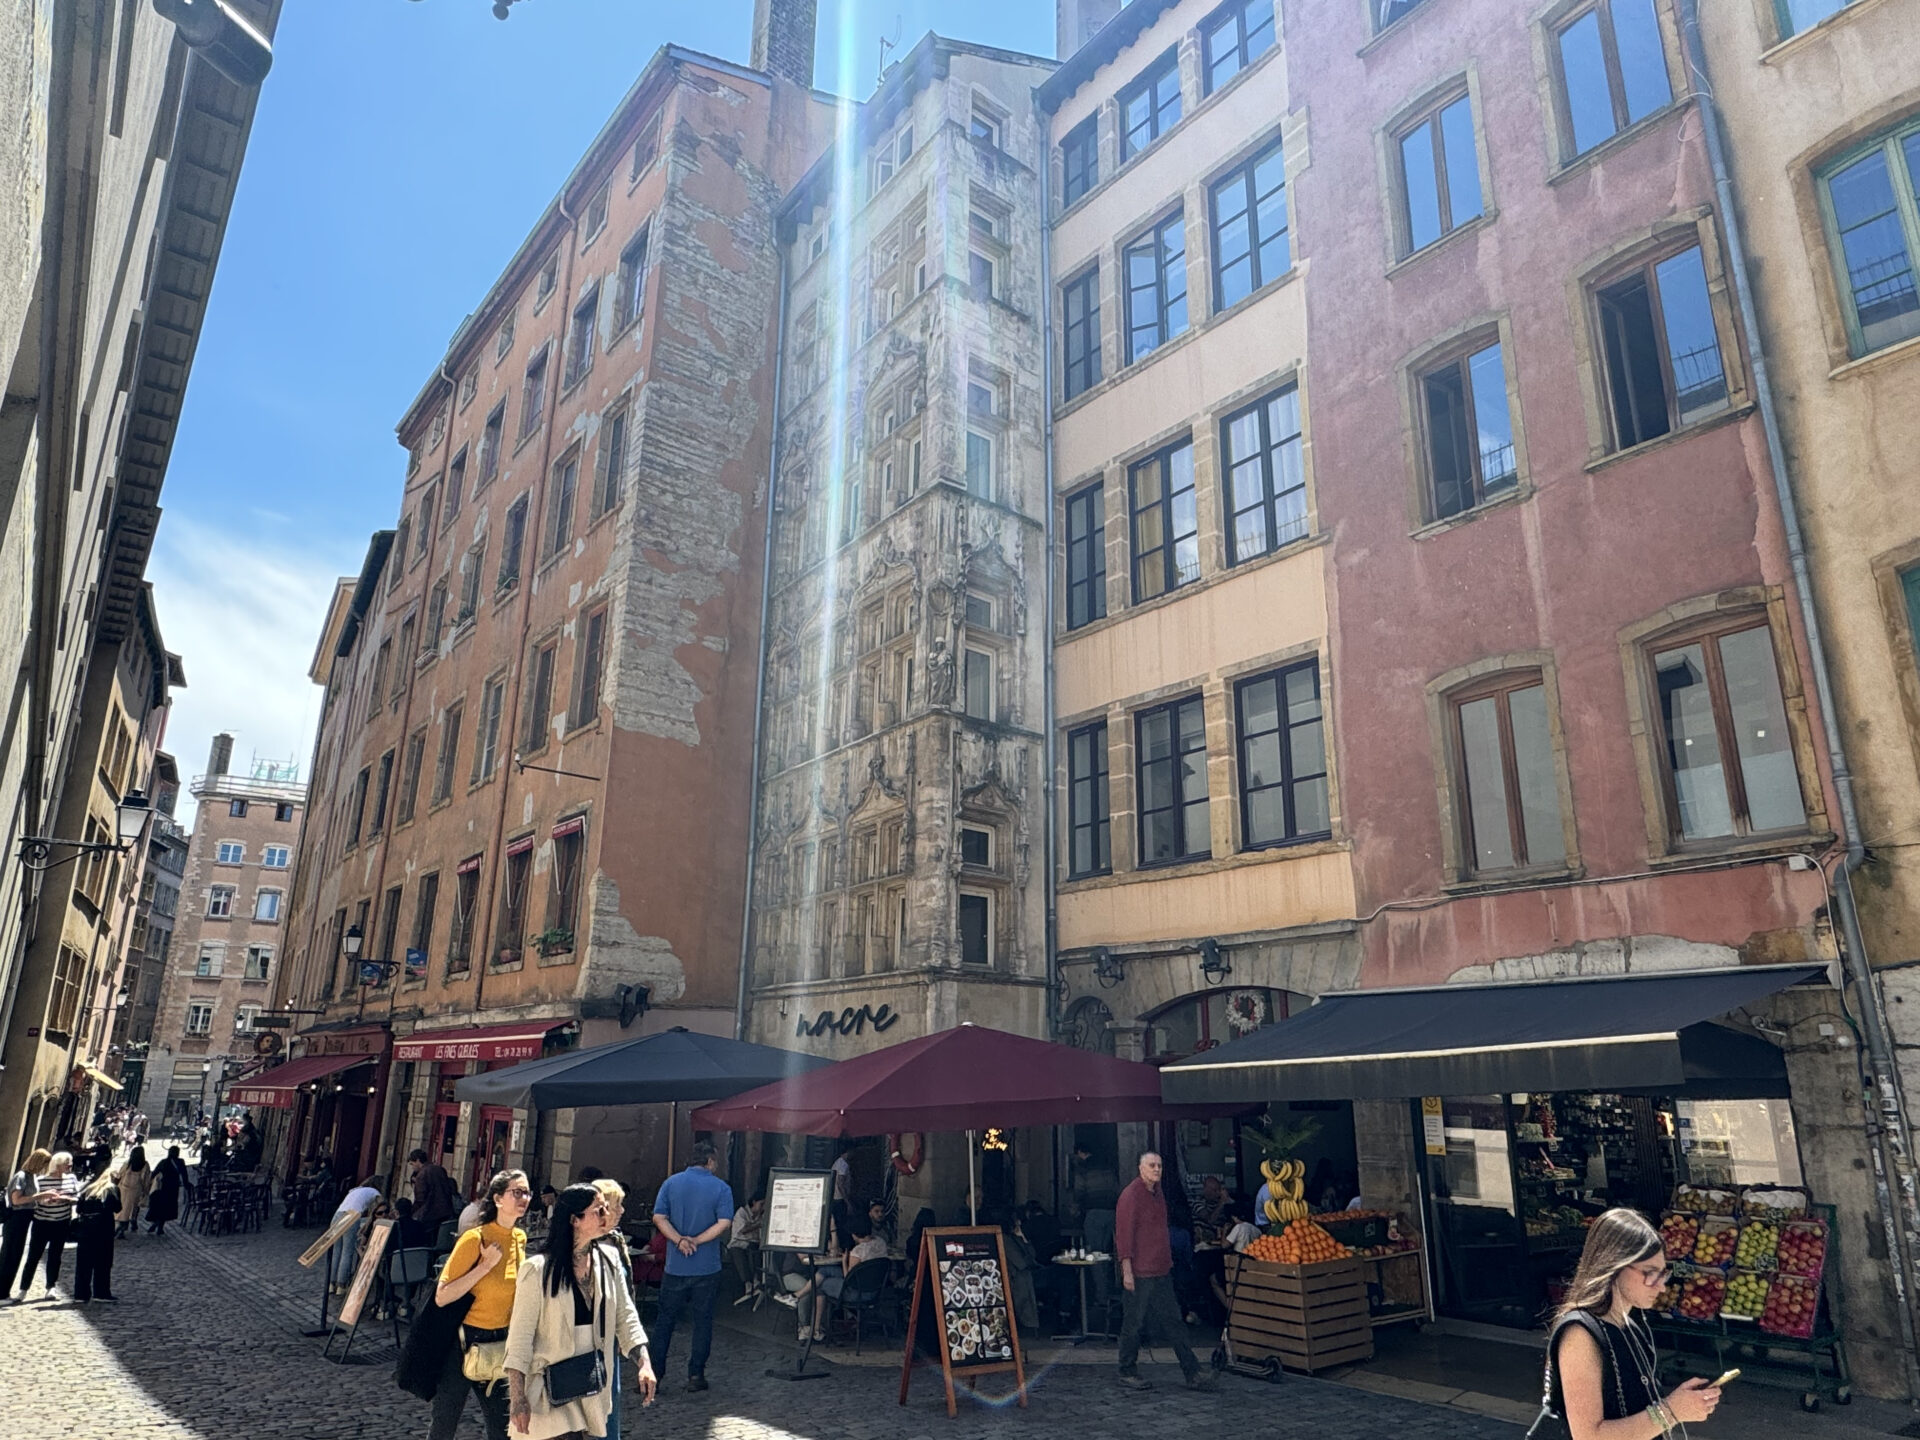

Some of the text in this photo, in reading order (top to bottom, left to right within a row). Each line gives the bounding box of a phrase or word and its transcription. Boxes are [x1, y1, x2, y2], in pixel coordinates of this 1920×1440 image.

[796, 1003, 898, 1037] nacre
[398, 1046, 425, 1058] RESTAURANT
[435, 1045, 444, 1058] LES
[444, 1045, 457, 1058] FINES
